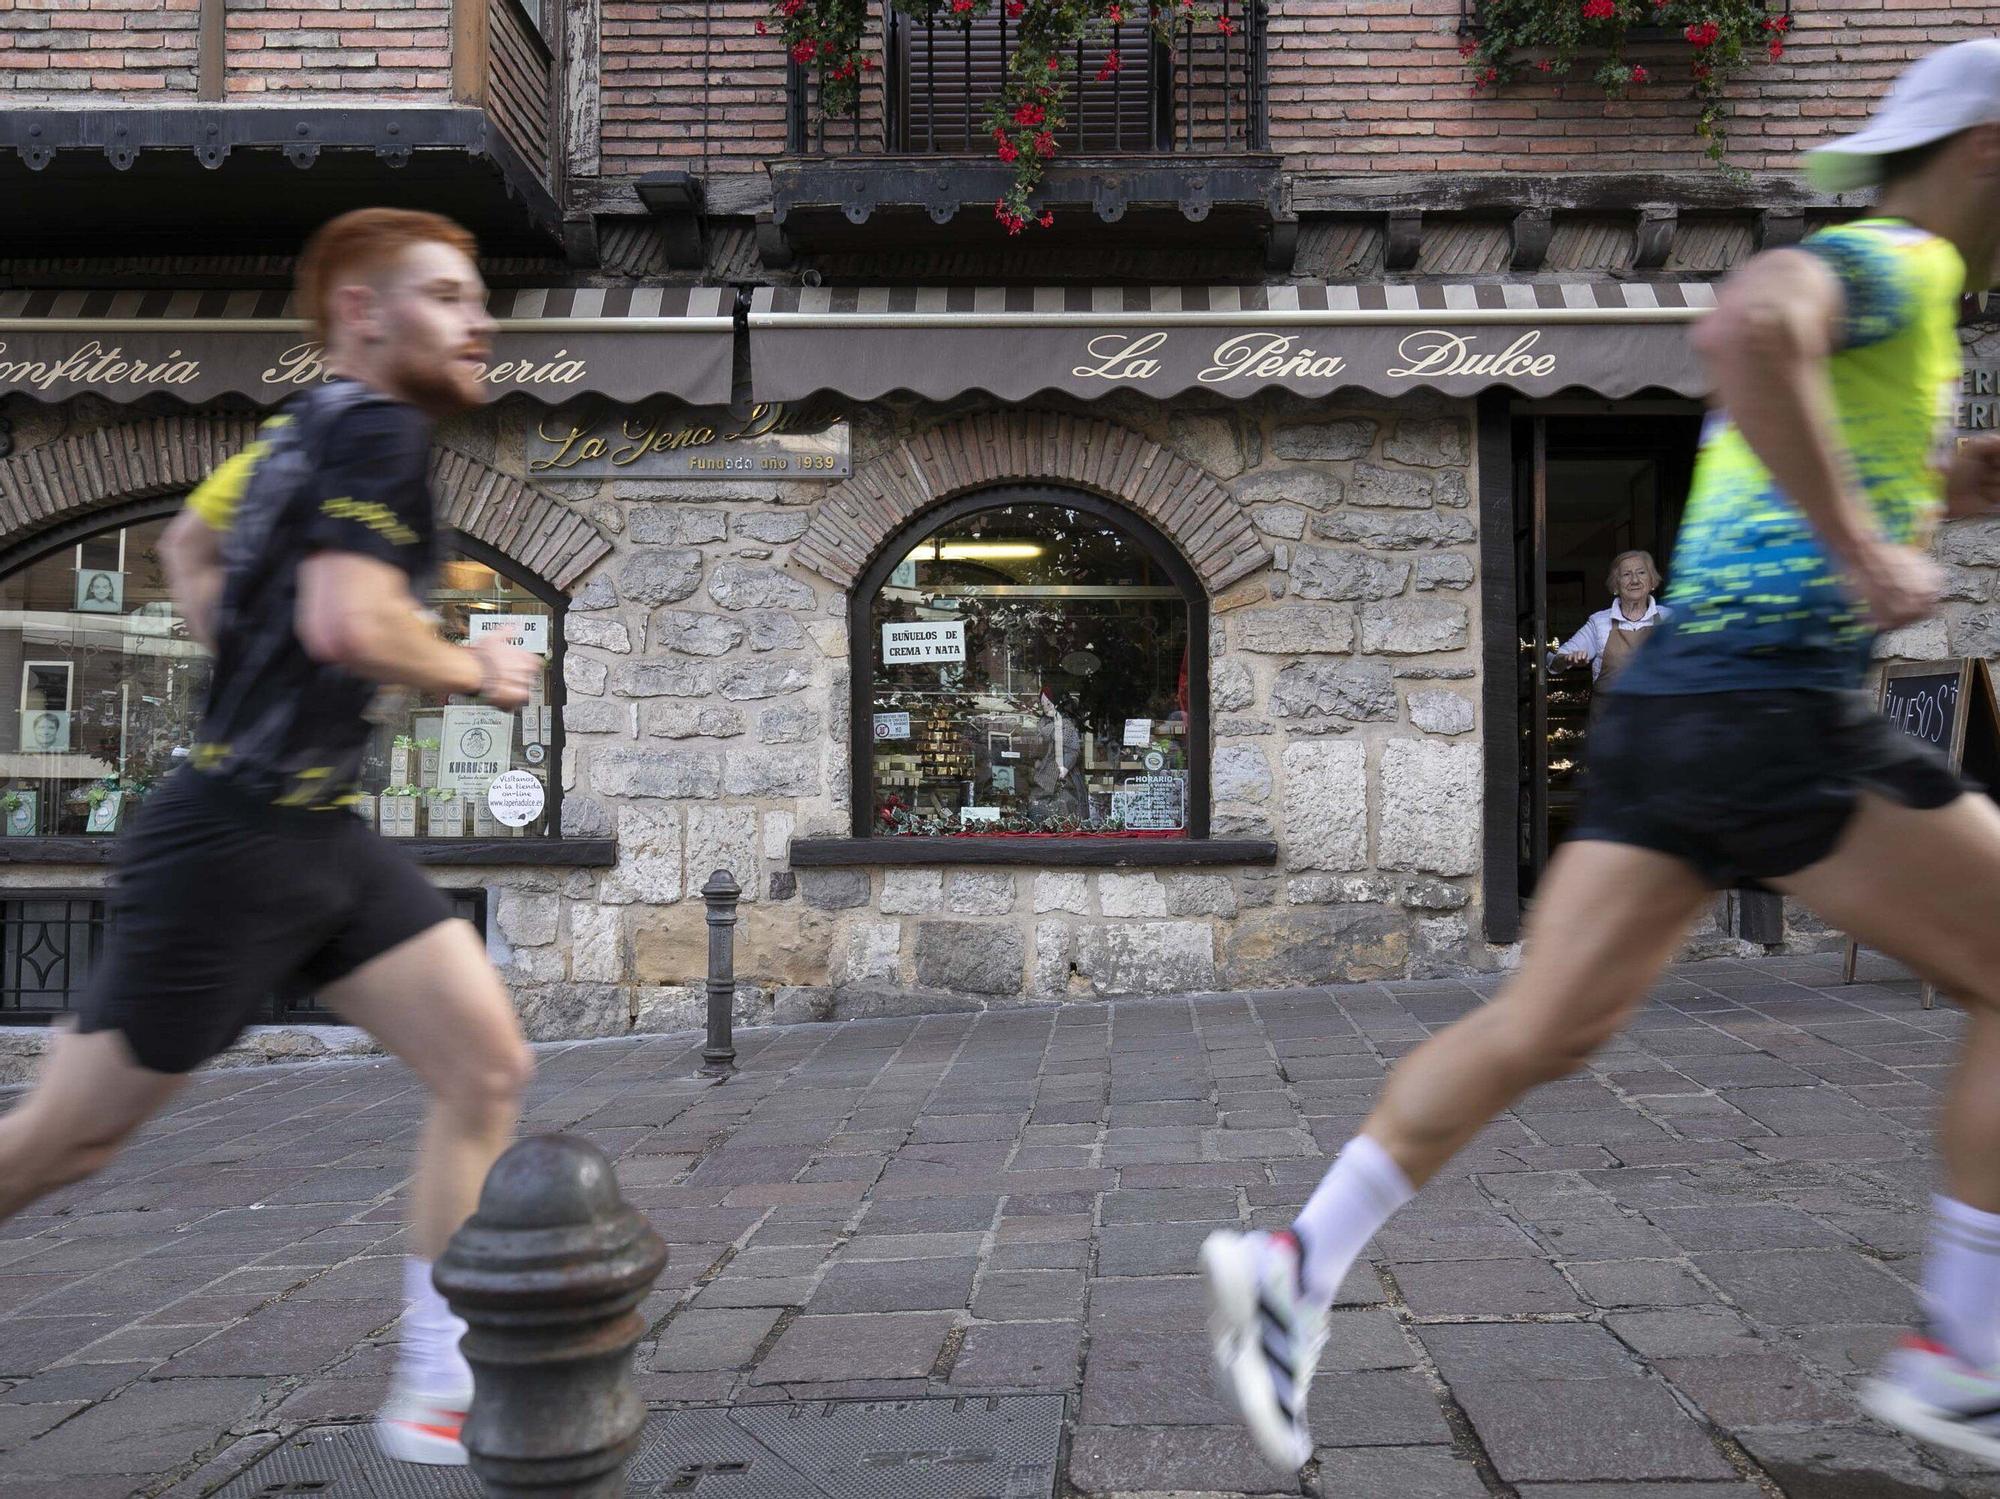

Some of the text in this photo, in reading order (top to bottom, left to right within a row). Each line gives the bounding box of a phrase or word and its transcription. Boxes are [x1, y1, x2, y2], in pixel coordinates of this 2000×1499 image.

[1072, 330, 1556, 382] La Peña Dulce
[0, 341, 200, 389] onfitería
[530, 408, 608, 470] La
[760, 455, 788, 470] año
[796, 456, 835, 469] 1939
[524, 622, 537, 631] DE
[891, 630, 958, 642] BUÑUELOS DE
[889, 645, 961, 657] CREMA Y NATA
[1135, 775, 1173, 783] HORARIO
